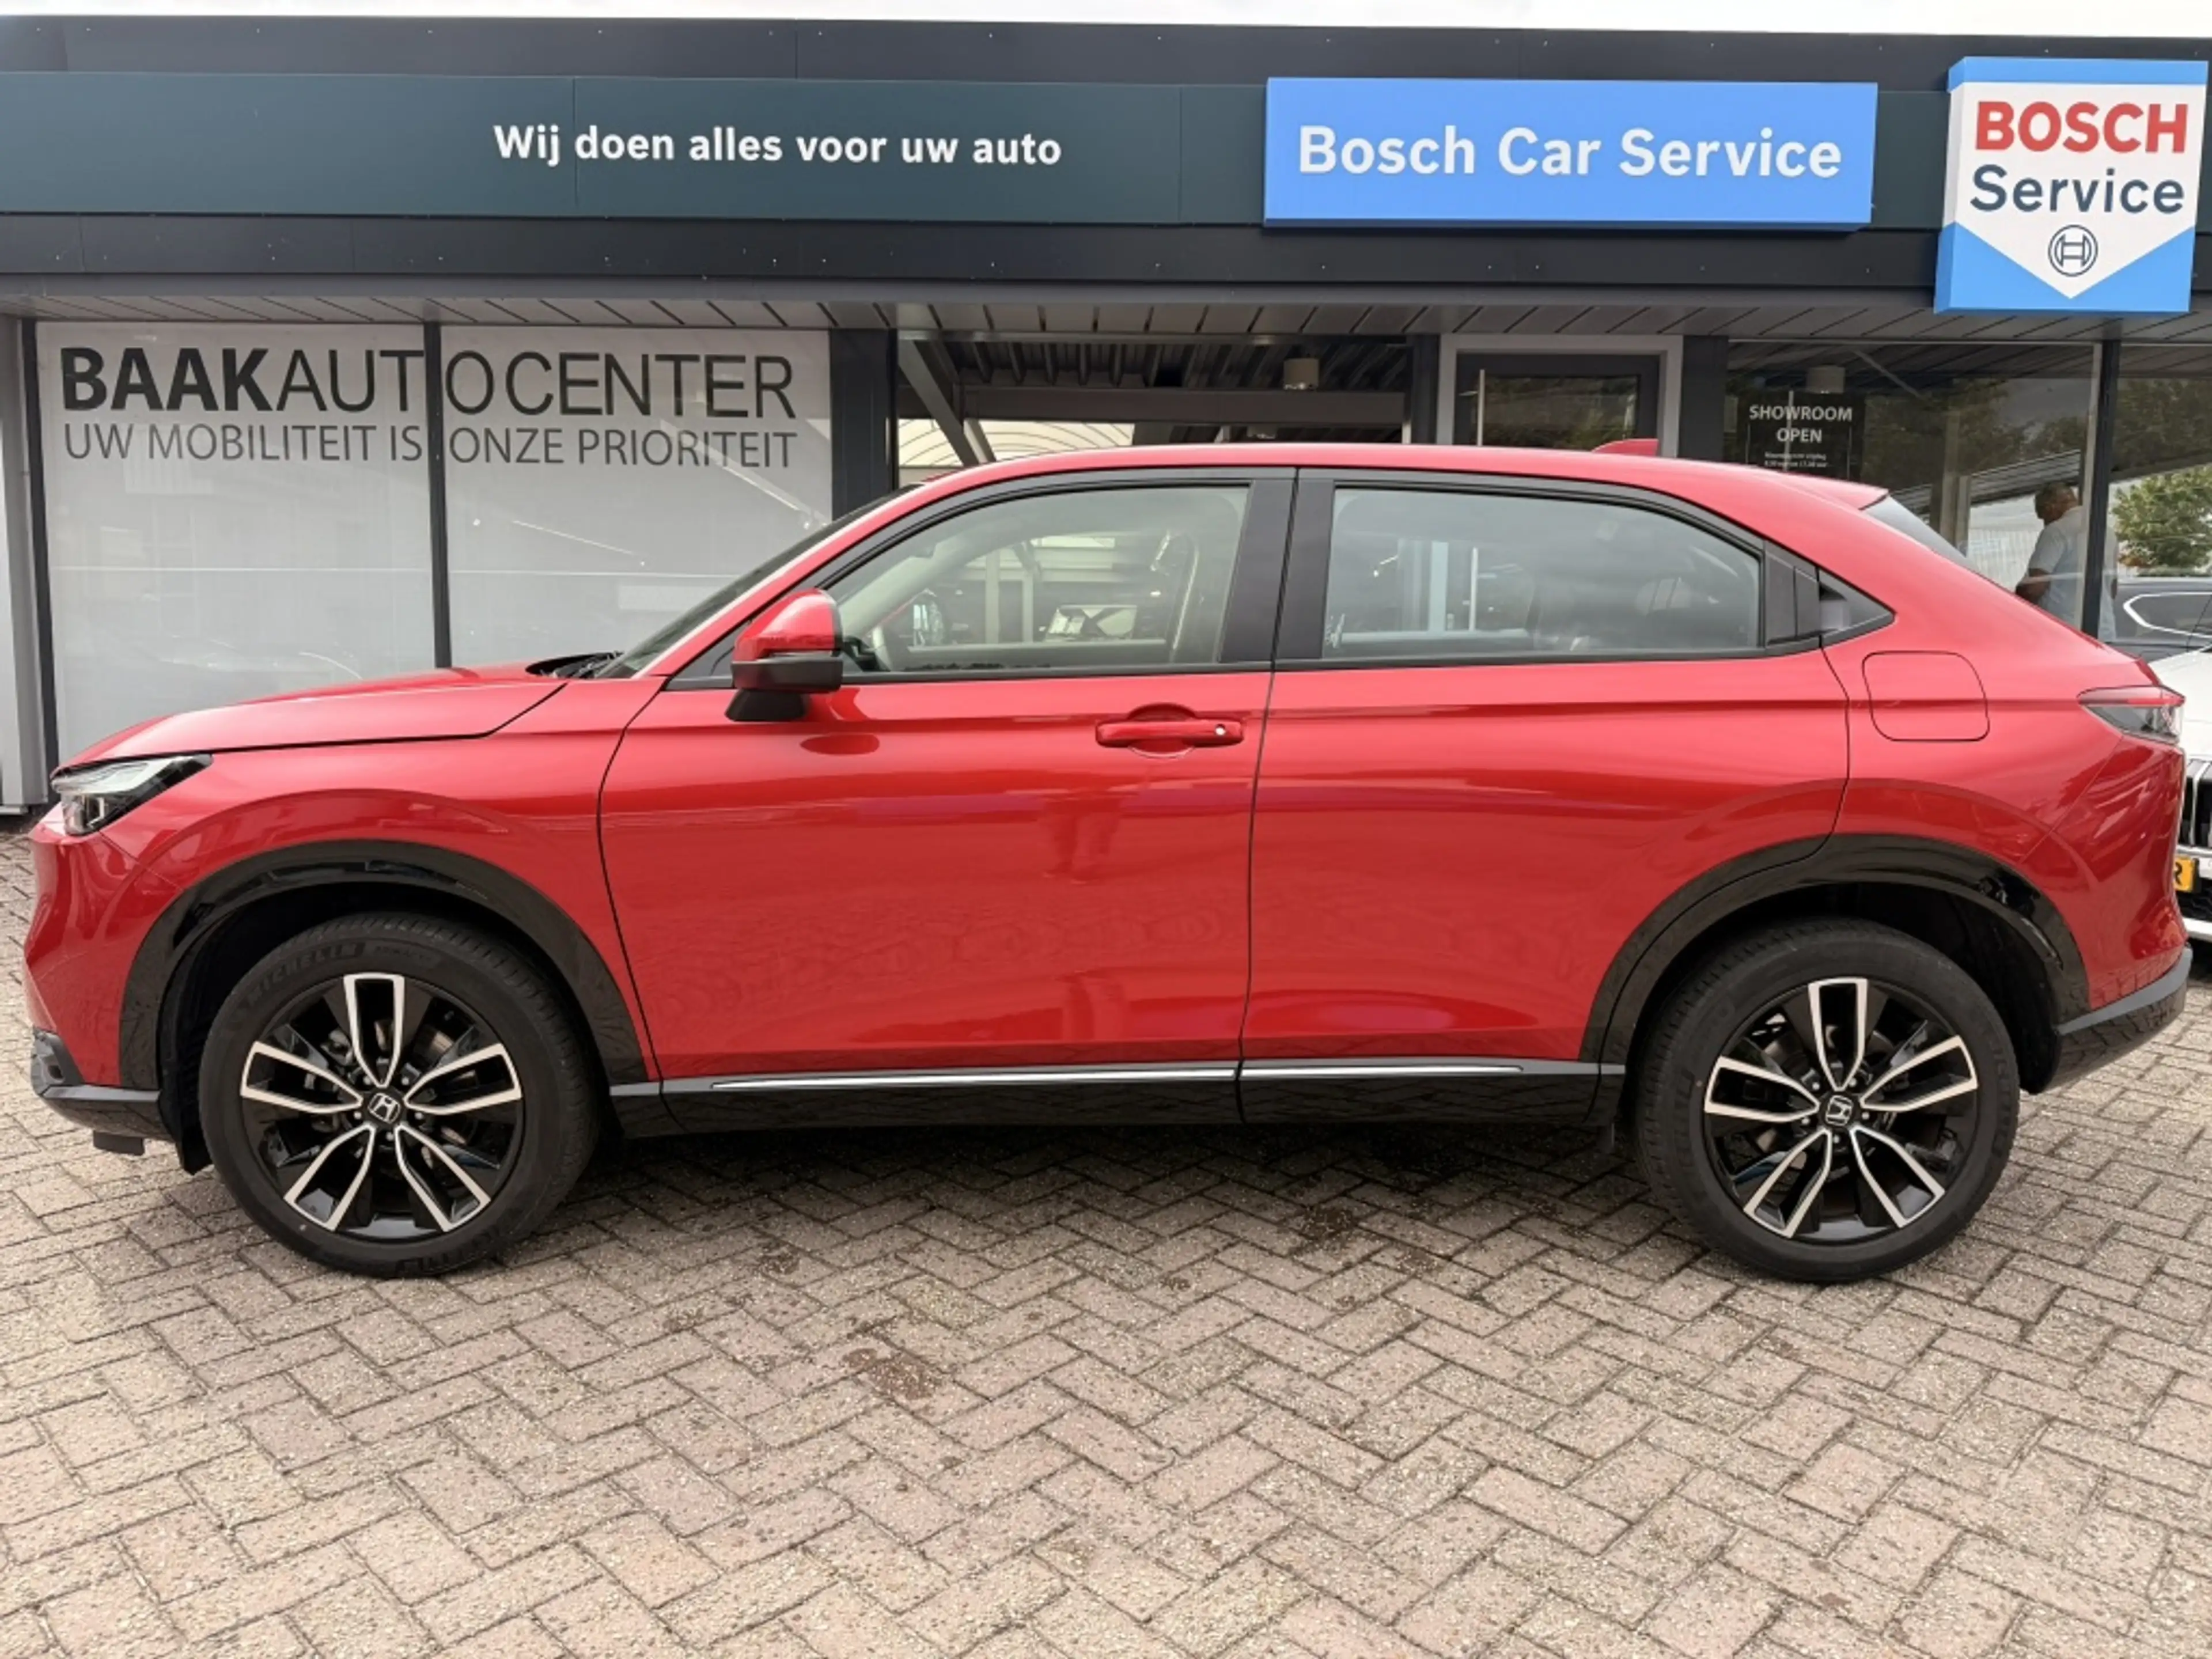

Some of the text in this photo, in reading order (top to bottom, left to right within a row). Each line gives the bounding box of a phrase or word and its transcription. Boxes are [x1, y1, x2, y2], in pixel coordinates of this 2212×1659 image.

[494, 124, 1062, 167] Wij doen alles voor uw auto
[1975, 101, 2188, 154] BOSCH
[1299, 125, 1842, 177] Bosch Car Service
[1970, 164, 2184, 214] Service
[1749, 405, 1853, 421] SHOWROOM
[1776, 427, 1823, 442] OPEN
[65, 423, 798, 468] UW MOBILITEIT IS ONZE PRIORITEIT
